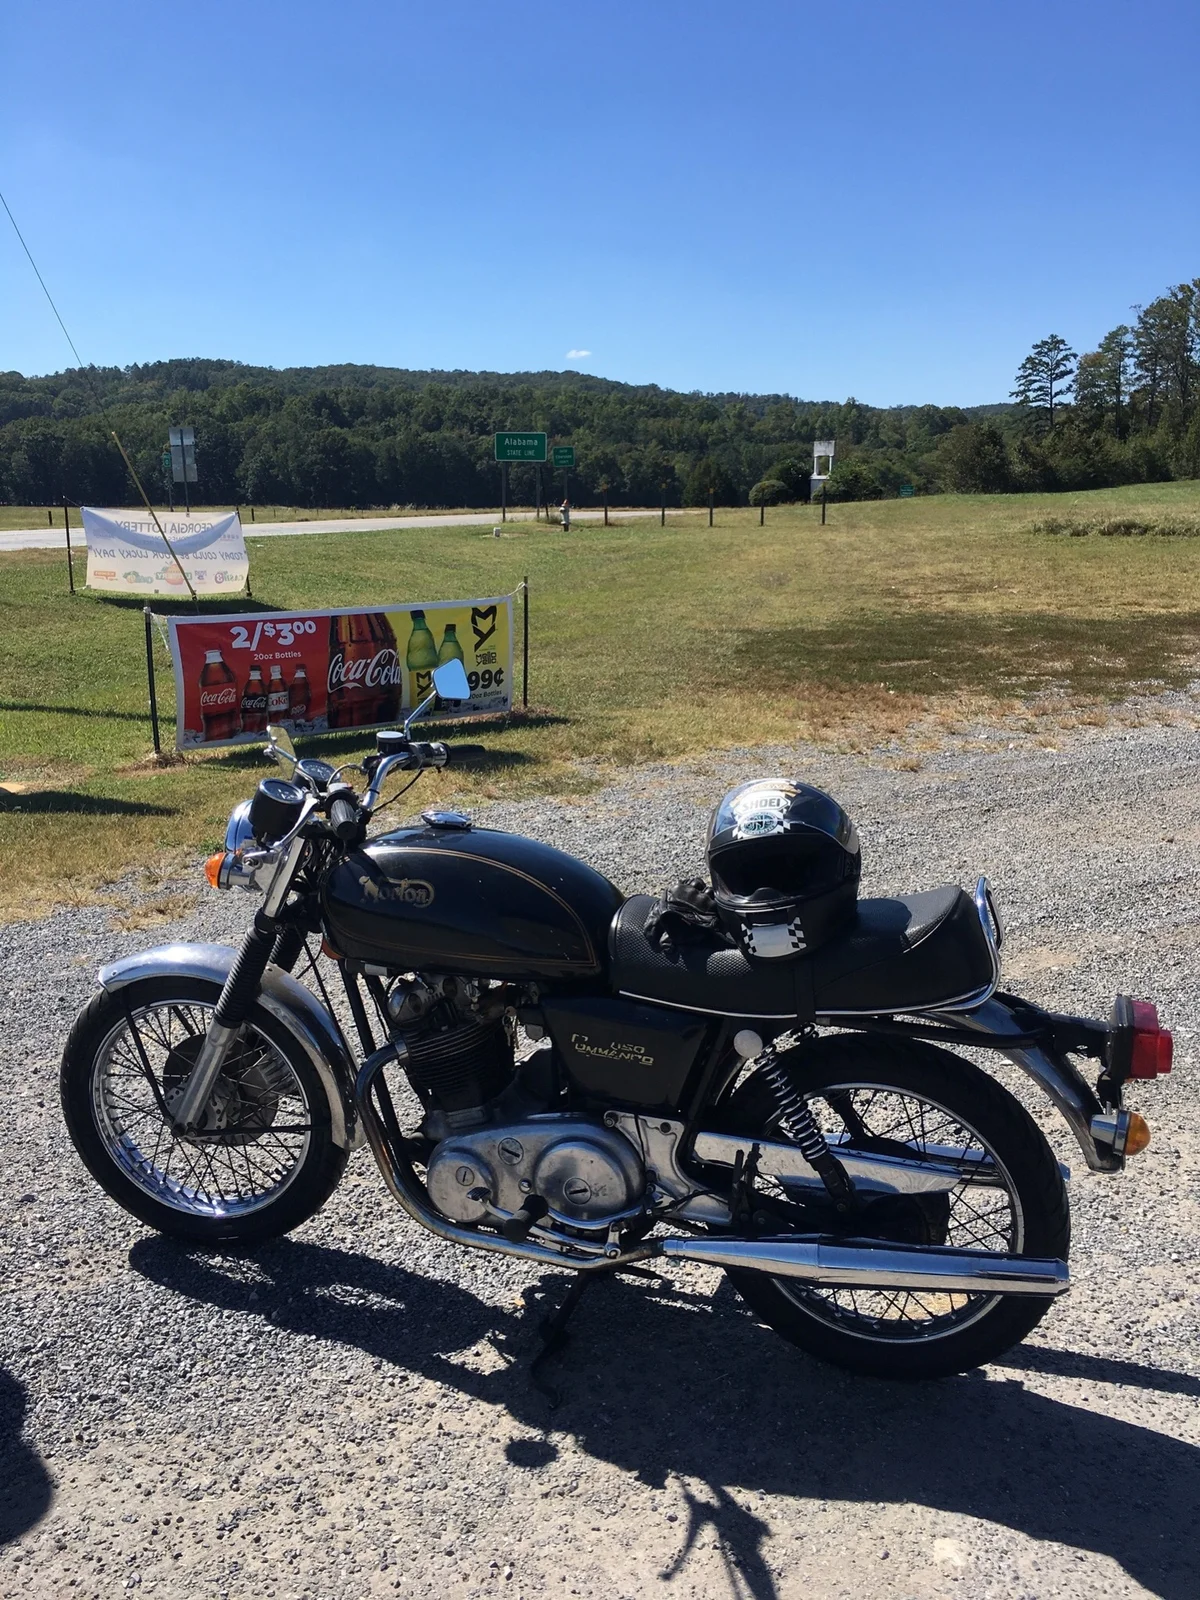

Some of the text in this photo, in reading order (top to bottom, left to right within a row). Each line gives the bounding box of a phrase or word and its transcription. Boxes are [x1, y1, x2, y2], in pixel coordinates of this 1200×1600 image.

[504, 437, 538, 446] Alabama
[253, 651, 302, 661] 20oz Bottles
[327, 648, 402, 694] Coca-Cola
[467, 668, 504, 691] 99¢
[200, 687, 237, 707] Coca-Cola
[484, 690, 502, 698] Bottles
[742, 797, 781, 811] SHOEI
[359, 876, 434, 908] Norton
